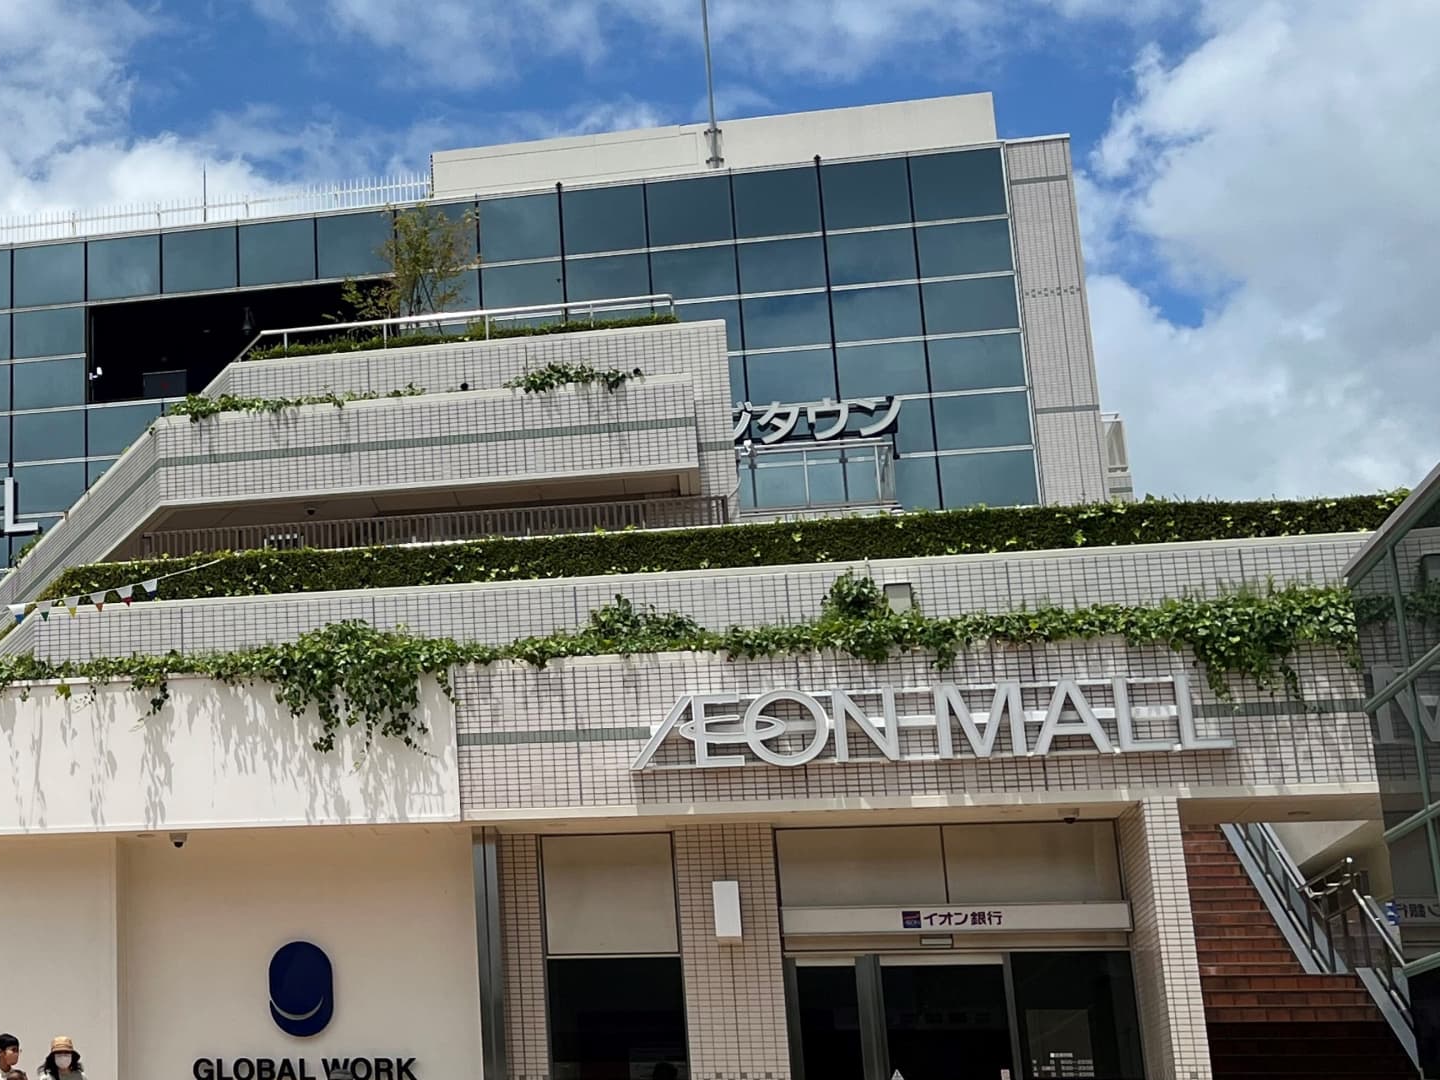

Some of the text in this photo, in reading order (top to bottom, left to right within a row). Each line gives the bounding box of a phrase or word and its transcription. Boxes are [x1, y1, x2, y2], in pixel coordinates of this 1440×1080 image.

[936, 674, 1236, 760] MALL
[924, 911, 1002, 926] イオン銀行
[193, 1057, 417, 1080] GLOBAL WORK
